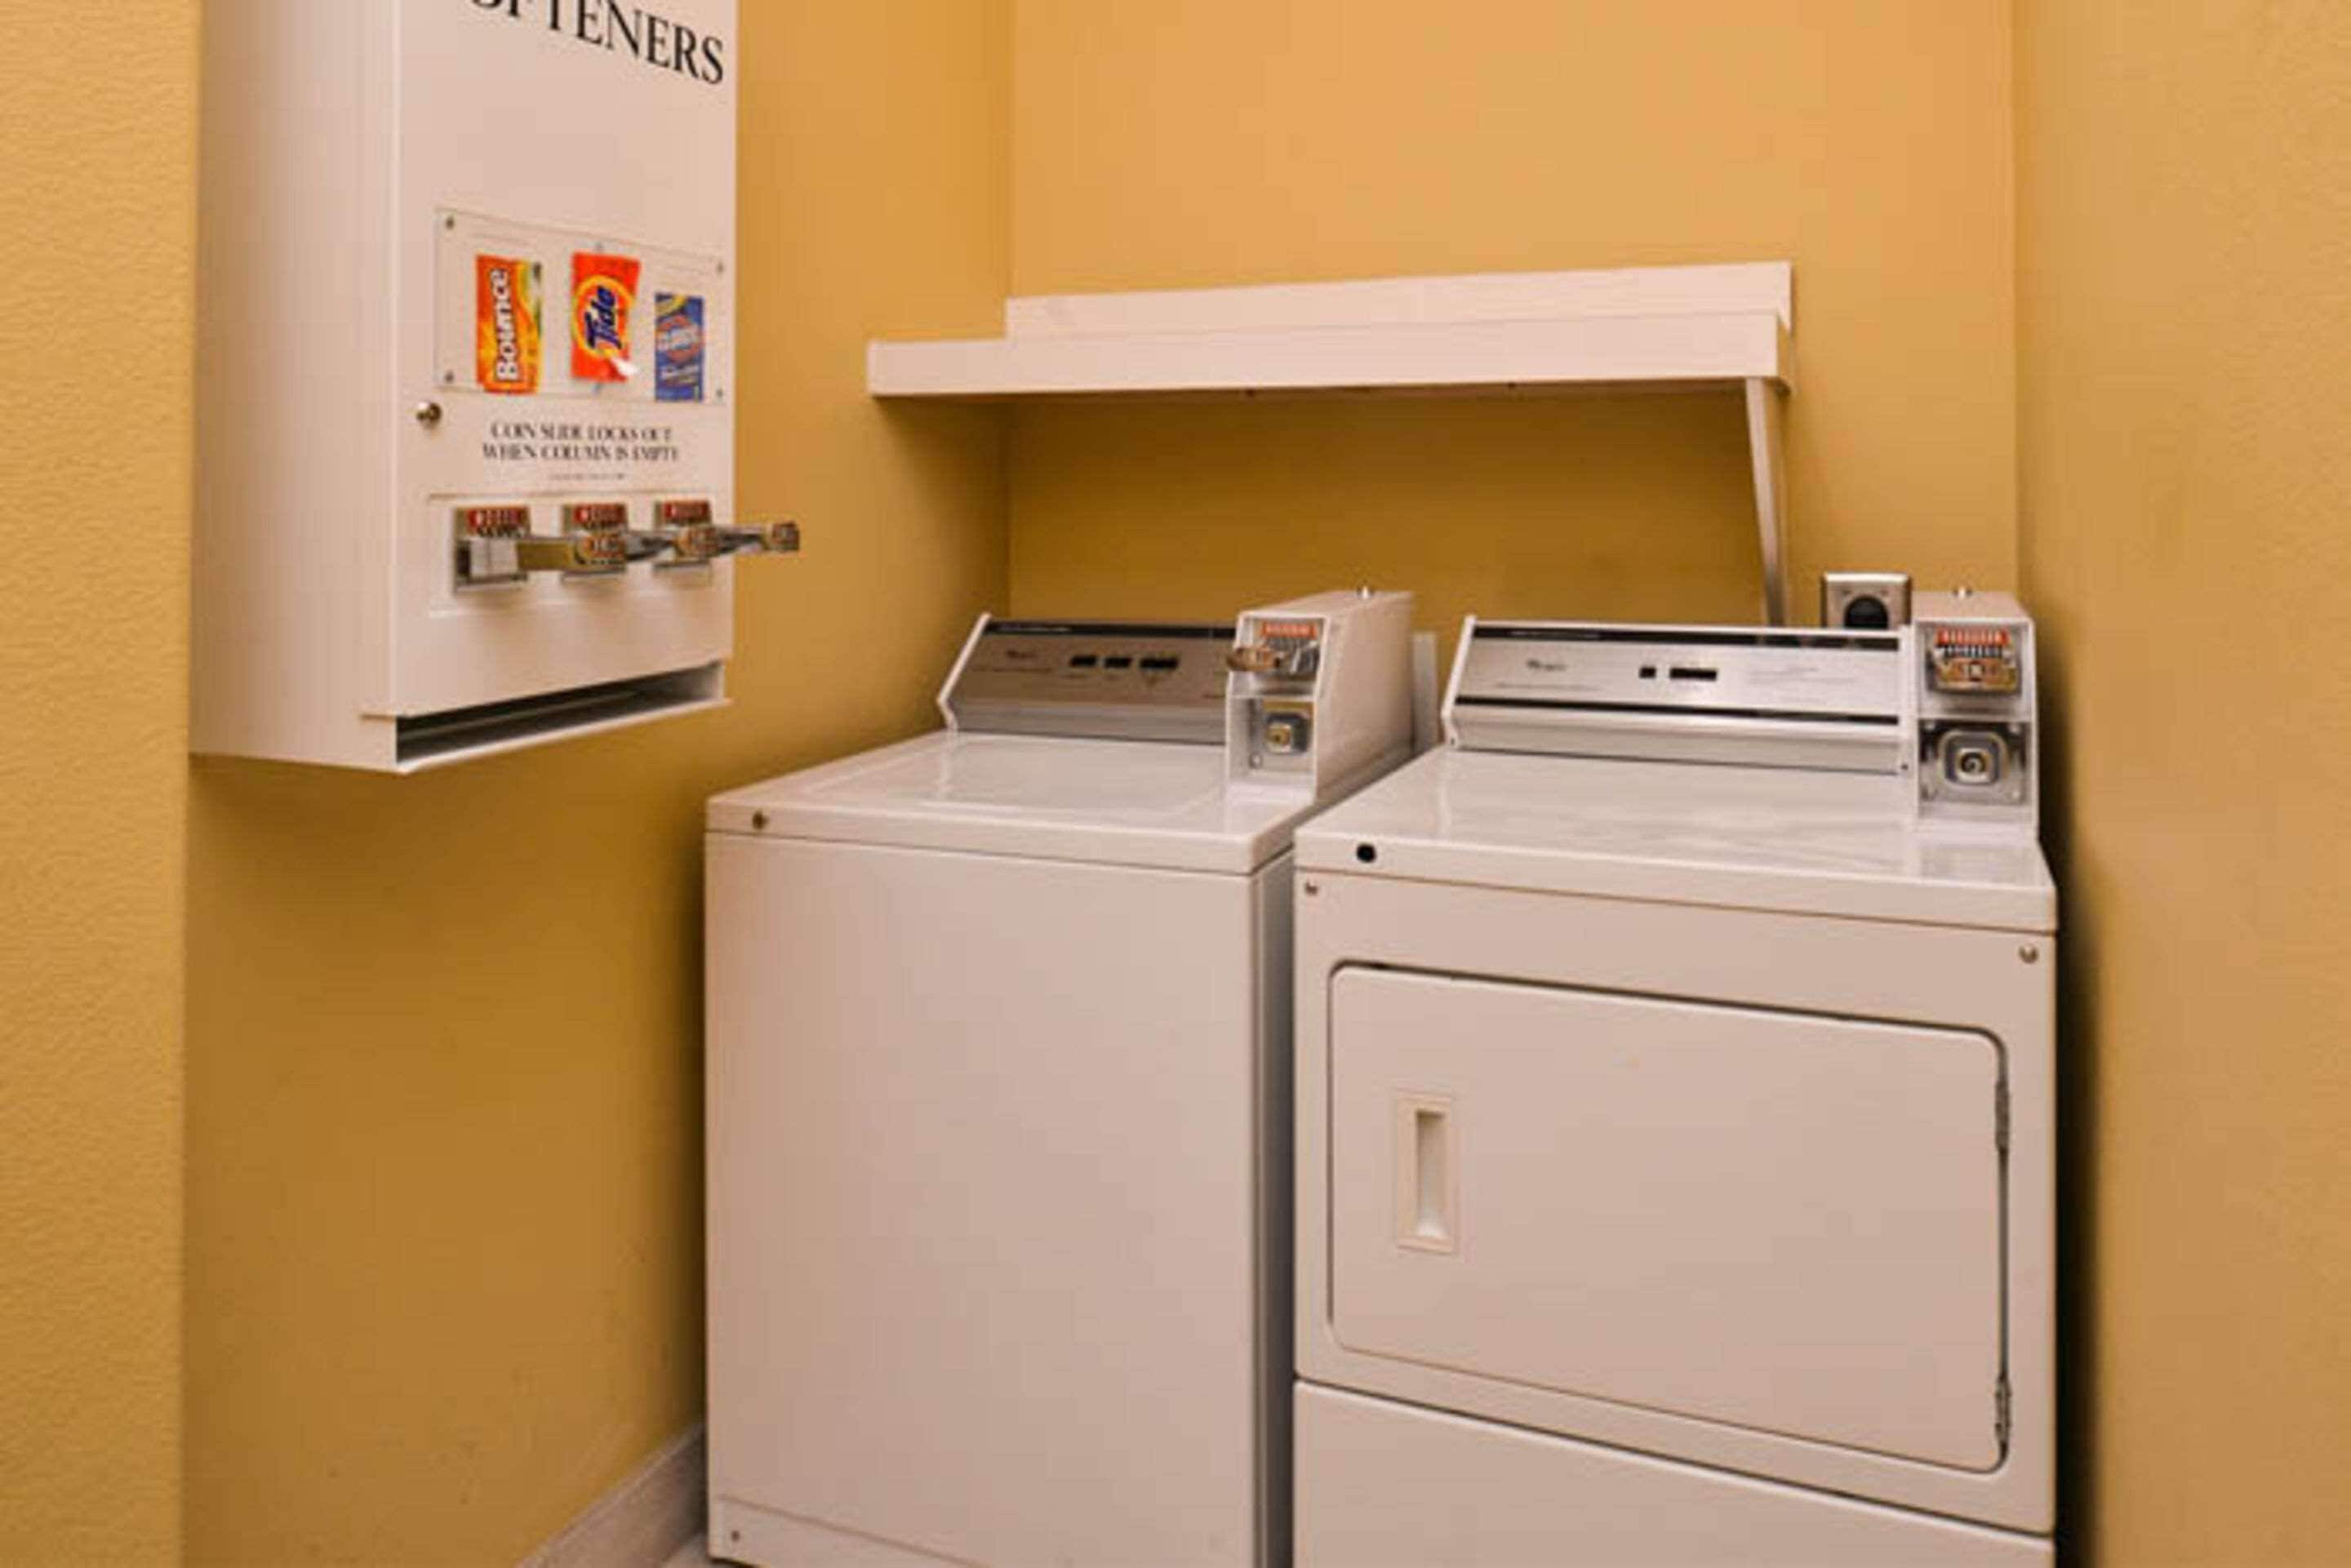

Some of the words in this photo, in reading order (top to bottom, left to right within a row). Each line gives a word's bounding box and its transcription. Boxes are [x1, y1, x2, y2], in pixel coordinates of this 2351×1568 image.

[470, 0, 725, 84] TENERS
[491, 269, 518, 380] Bounce
[584, 284, 623, 350] Tide
[482, 442, 537, 460] WHEN
[540, 445, 612, 460] COLUMN
[587, 425, 638, 442] LOCKS
